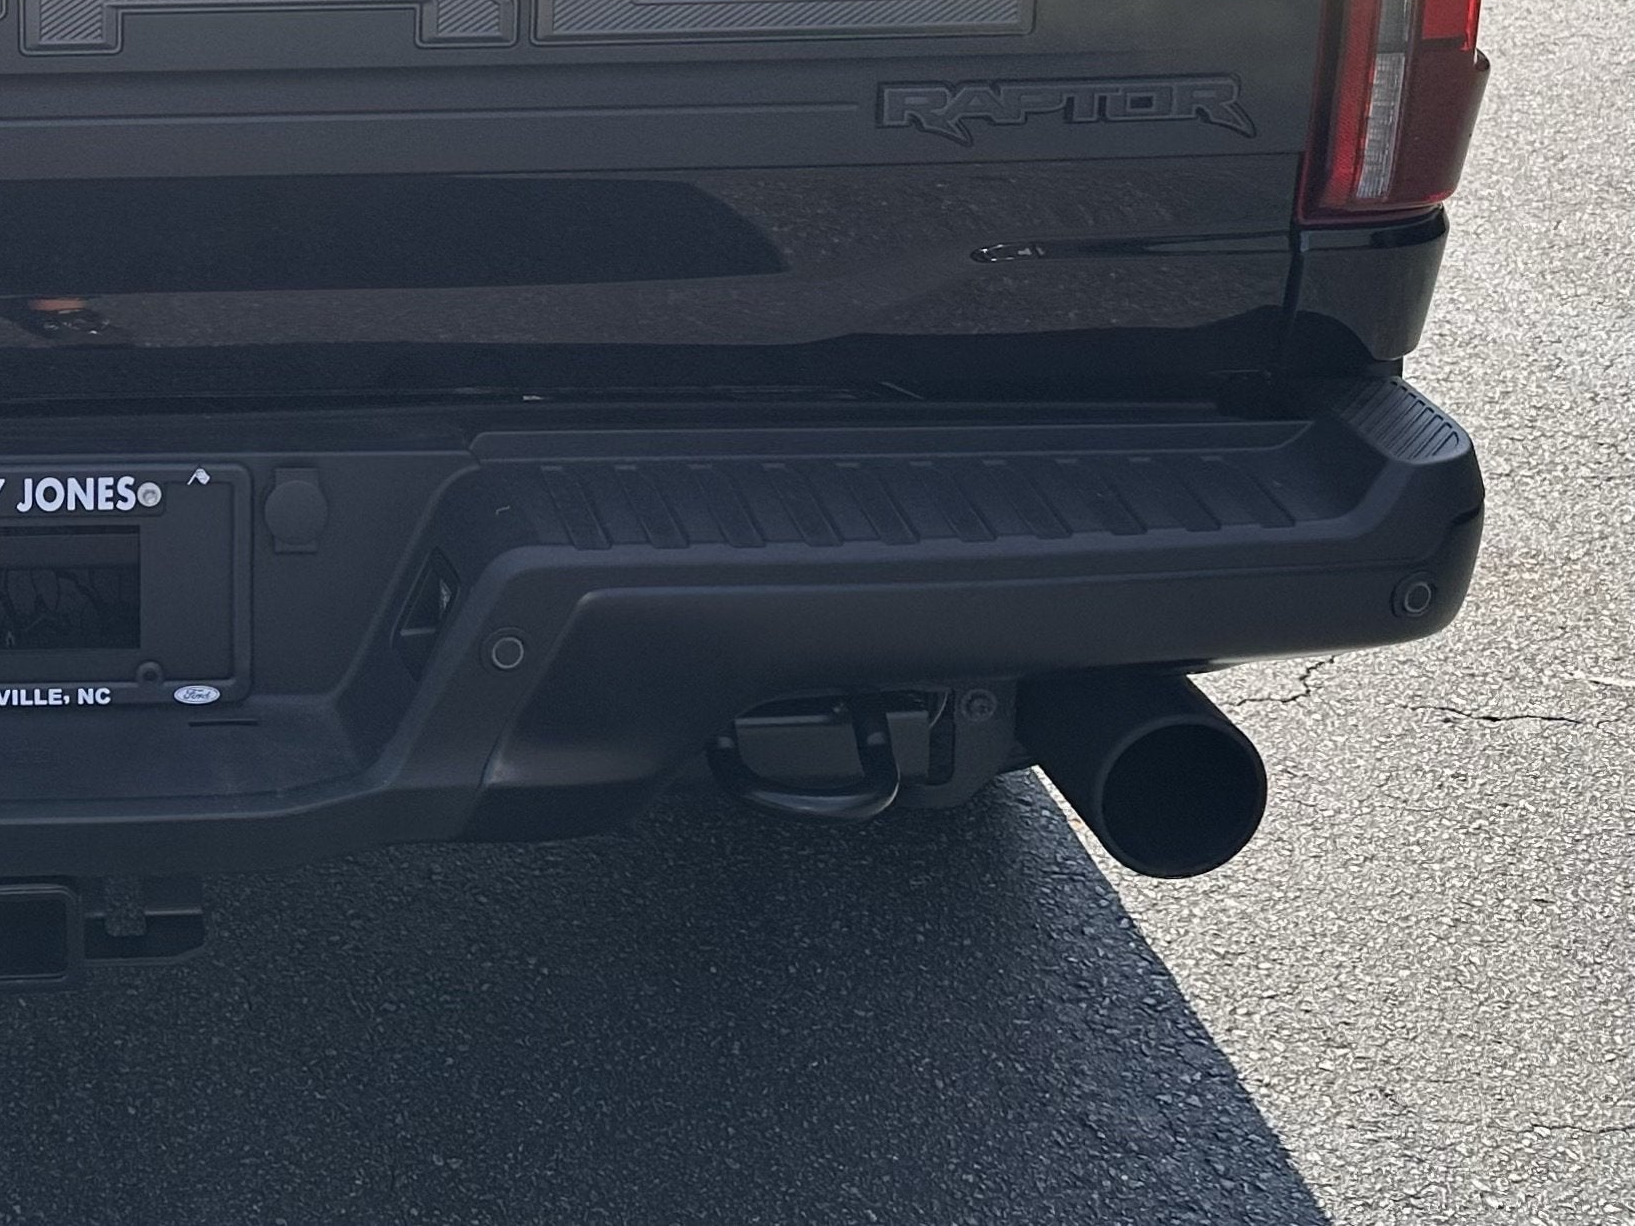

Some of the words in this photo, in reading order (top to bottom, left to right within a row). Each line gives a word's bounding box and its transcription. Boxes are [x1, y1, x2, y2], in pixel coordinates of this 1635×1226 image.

[876, 74, 1257, 147] RAPTOR
[16, 475, 137, 512] JONES
[77, 687, 112, 705] NC
